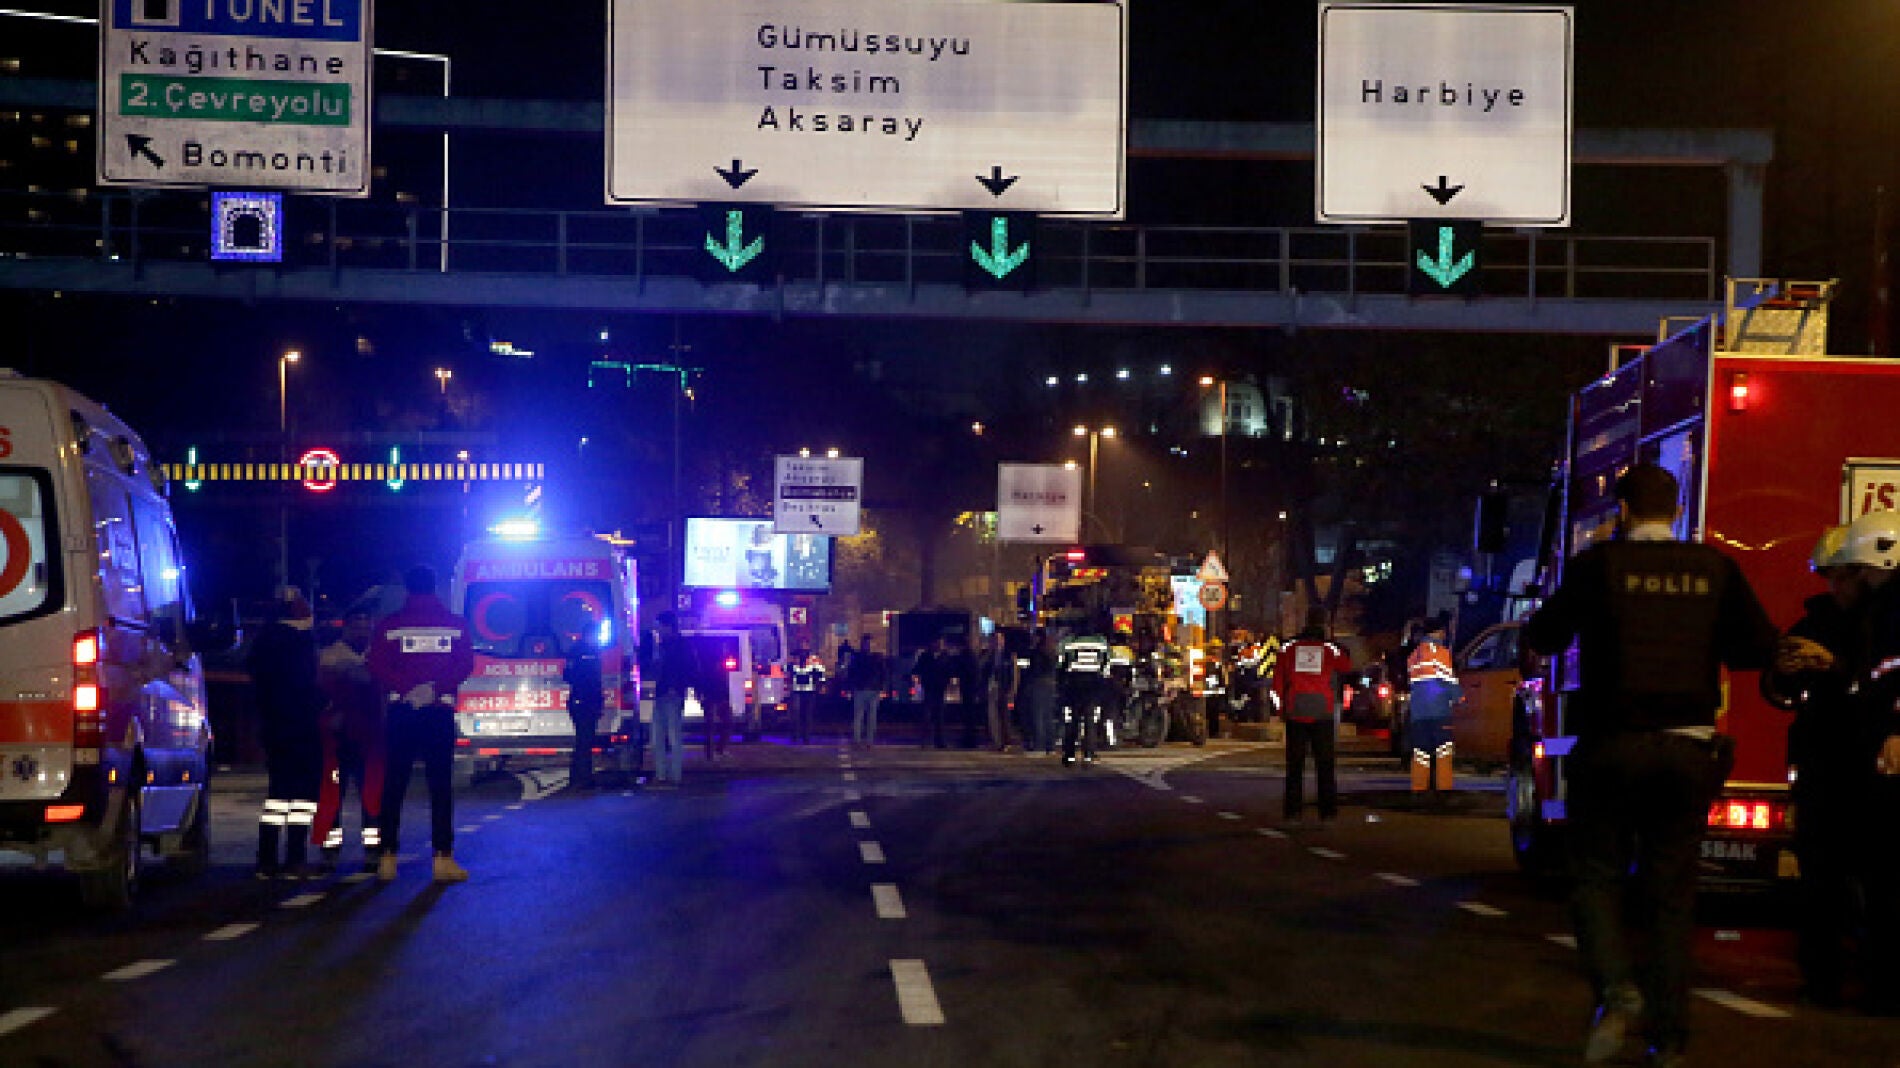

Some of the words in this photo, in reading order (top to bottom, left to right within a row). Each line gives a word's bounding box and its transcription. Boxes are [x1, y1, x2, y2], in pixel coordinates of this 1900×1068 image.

[130, 40, 344, 74] Kağıthane
[757, 24, 970, 62] Gümüşsuyu
[757, 66, 900, 93] Taksim
[1362, 79, 1525, 113] Harbiye
[757, 105, 923, 142] Aksaray
[182, 140, 348, 174] Bomonti
[476, 561, 600, 580] AMBULANS
